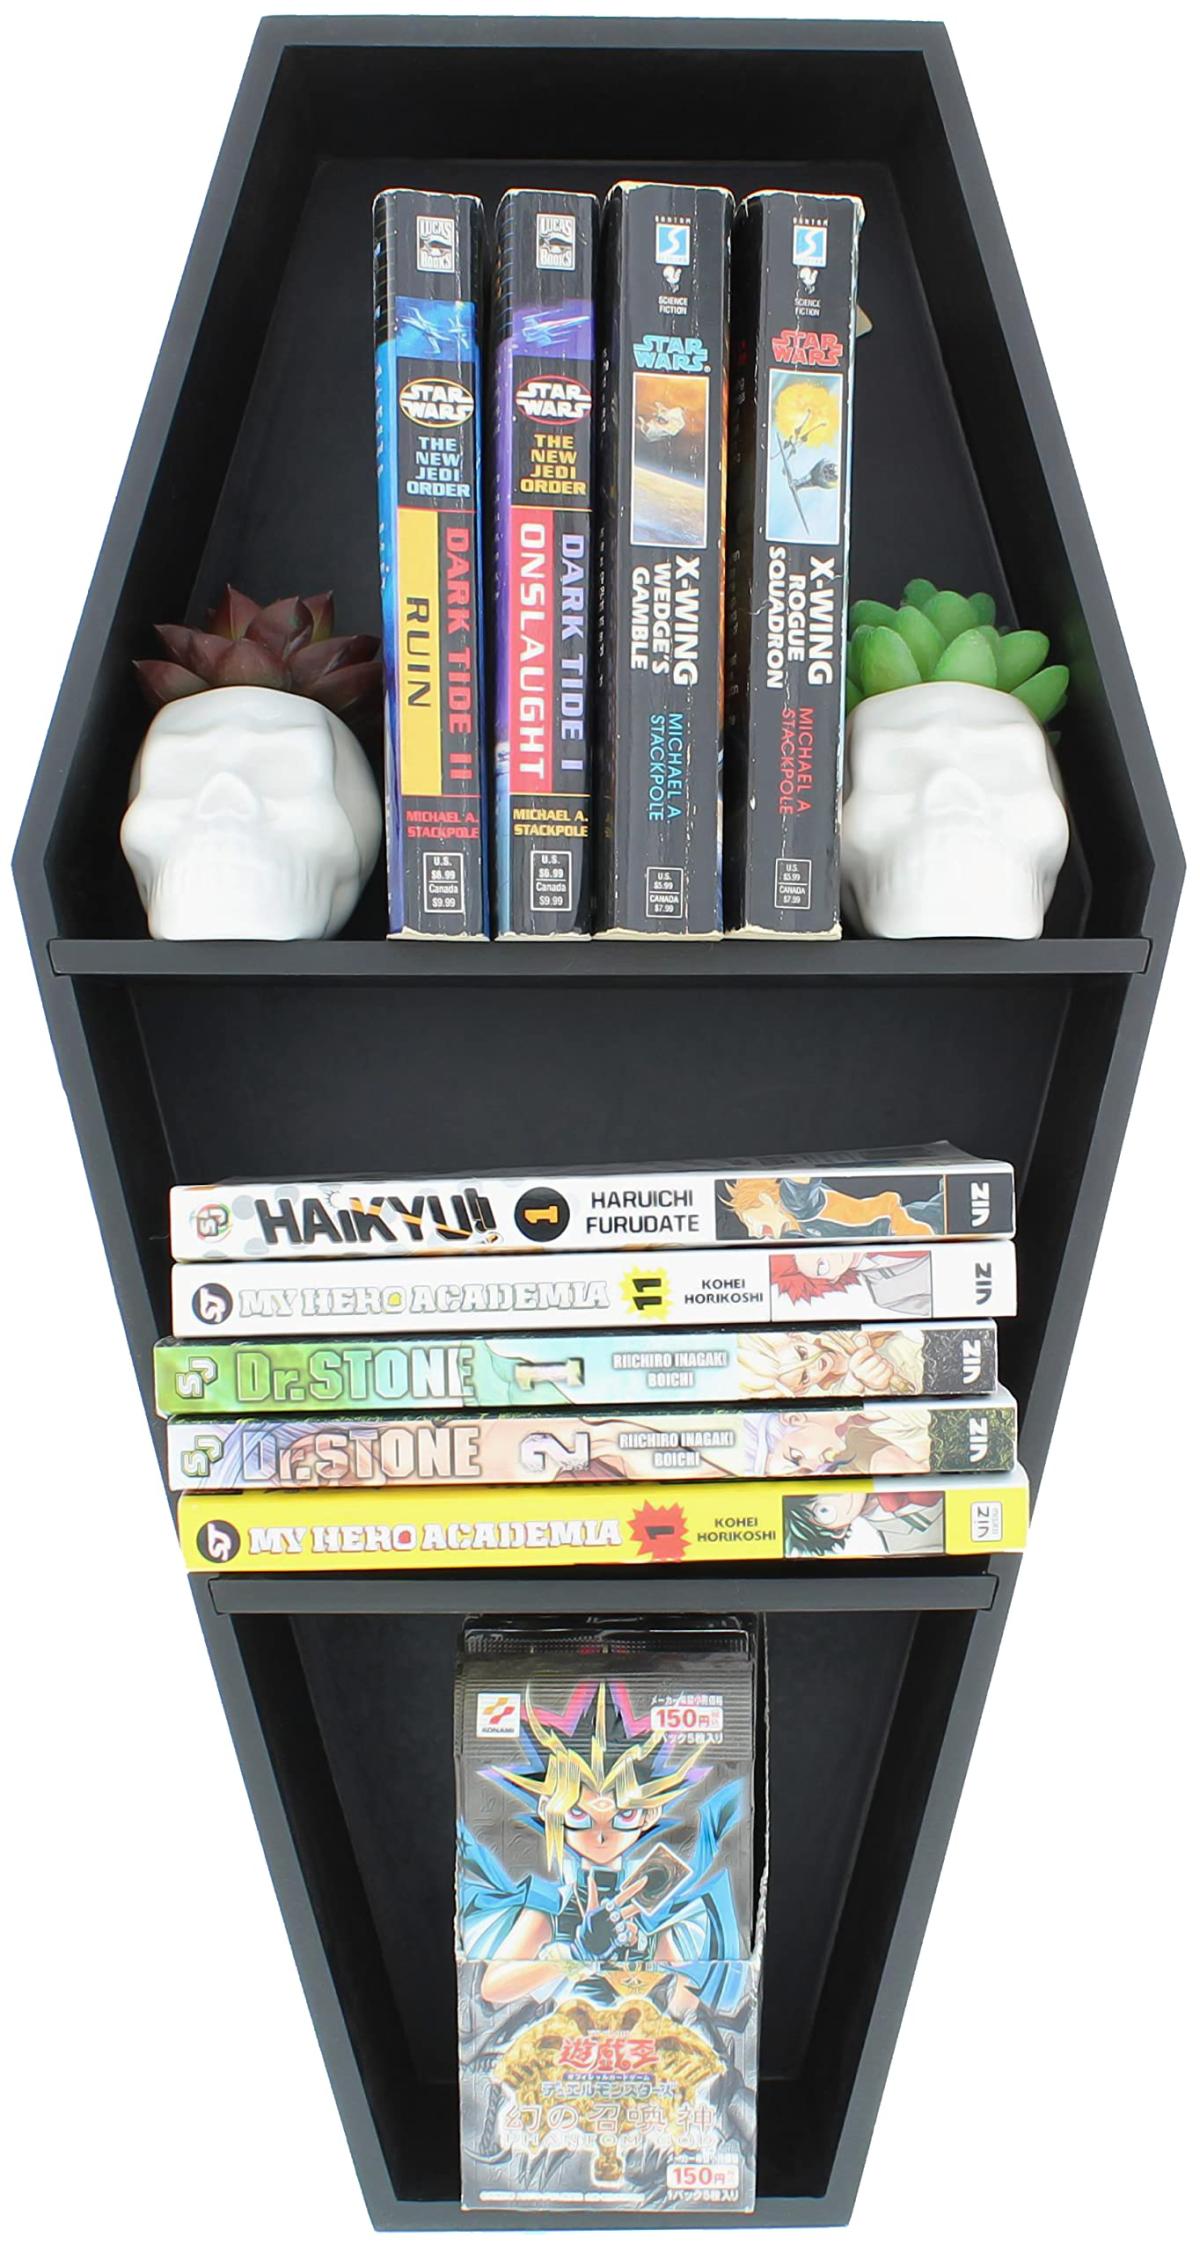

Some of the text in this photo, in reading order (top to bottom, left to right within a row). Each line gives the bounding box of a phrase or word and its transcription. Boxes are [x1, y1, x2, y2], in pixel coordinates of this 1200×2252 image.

[420, 220, 453, 241] LUCAS
[540, 217, 573, 237] LUCAS
[420, 250, 453, 269] BOOKS
[540, 249, 573, 267] BOOKS
[658, 295, 689, 306] SCIENCE
[659, 304, 688, 315] FICTION
[795, 298, 821, 308] SCIENCE
[794, 306, 820, 316] FICTION
[633, 334, 708, 354] STAR
[772, 330, 844, 351] STAR
[633, 351, 708, 372] WARS
[772, 347, 844, 366] WARS
[400, 384, 473, 401] STAR
[515, 381, 591, 400] STAR
[401, 400, 474, 421] WARS
[517, 399, 591, 419] WARS
[418, 436, 457, 452] THE
[533, 433, 574, 450] THE
[416, 451, 461, 467] NEW
[531, 449, 577, 465] NEW
[415, 466, 460, 482] JEDI
[530, 464, 577, 480] JEDI
[406, 480, 471, 498] ORDER
[520, 478, 587, 496] ORDER
[630, 566, 651, 671] GAMBLE
[653, 563, 672, 676] WEDGE'S
[672, 554, 701, 688] X-WING
[766, 546, 786, 689] SQUADRON
[787, 573, 806, 663] ROGUE
[807, 556, 835, 686] X-WING
[406, 597, 432, 708] RUIN
[446, 527, 474, 780] DARK TIDE II
[518, 522, 546, 779] ONSLAUGHT
[561, 534, 585, 772] DARK TIDE I
[666, 713, 684, 798] MICHAEL
[796, 707, 814, 793] MICHAEL
[648, 714, 666, 822] STACKPOLE
[780, 708, 796, 815] STACKPOLE
[406, 810, 480, 823] MICHAEL A.
[513, 808, 588, 821] MICHAEL A.
[407, 826, 480, 838] STACKPOLE
[513, 824, 589, 837] STACKPOLE
[433, 856, 452, 866] U.S.
[541, 855, 560, 864] U.S.
[428, 883, 459, 894] Canada
[535, 882, 567, 892] Canada
[779, 885, 806, 895] CANADA
[432, 897, 456, 908] $9.99
[538, 895, 563, 906] $9.99
[649, 894, 680, 904] CANADA
[591, 1189, 694, 1209] HARUICHI
[970, 1181, 990, 1228] VIZ
[524, 1204, 559, 1225] 1
[586, 1214, 699, 1235] FURUDATE
[701, 1278, 746, 1291] KOHEI
[974, 1262, 992, 1306] VIZ
[239, 1289, 297, 1318] MY
[302, 1285, 408, 1317] HERO
[412, 1279, 610, 1314] ACADEMIA
[633, 1277, 662, 1311] 11
[684, 1291, 764, 1305] HORIKOSHI
[612, 1351, 728, 1370] RIICHIRO INAGAKI
[961, 1340, 982, 1384] VIZ
[236, 1347, 475, 1402] Dr.STONE
[647, 1371, 694, 1388] BOICHI
[619, 1431, 735, 1450] RIICHIRO INAGAKI
[969, 1418, 989, 1463] VIZ
[242, 1426, 482, 1482] Dr.STONE
[520, 1432, 590, 1472] 2
[652, 1451, 700, 1468] BOICHI
[714, 1516, 759, 1529] KOHEI
[976, 1505, 990, 1538] VIZ
[248, 1527, 306, 1555] MY
[312, 1524, 418, 1554] HERO
[421, 1519, 623, 1551] ACADEMIA
[697, 1529, 776, 1543] HORIKOSHI
[541, 2081, 678, 2099] デュエルモンスターズ
